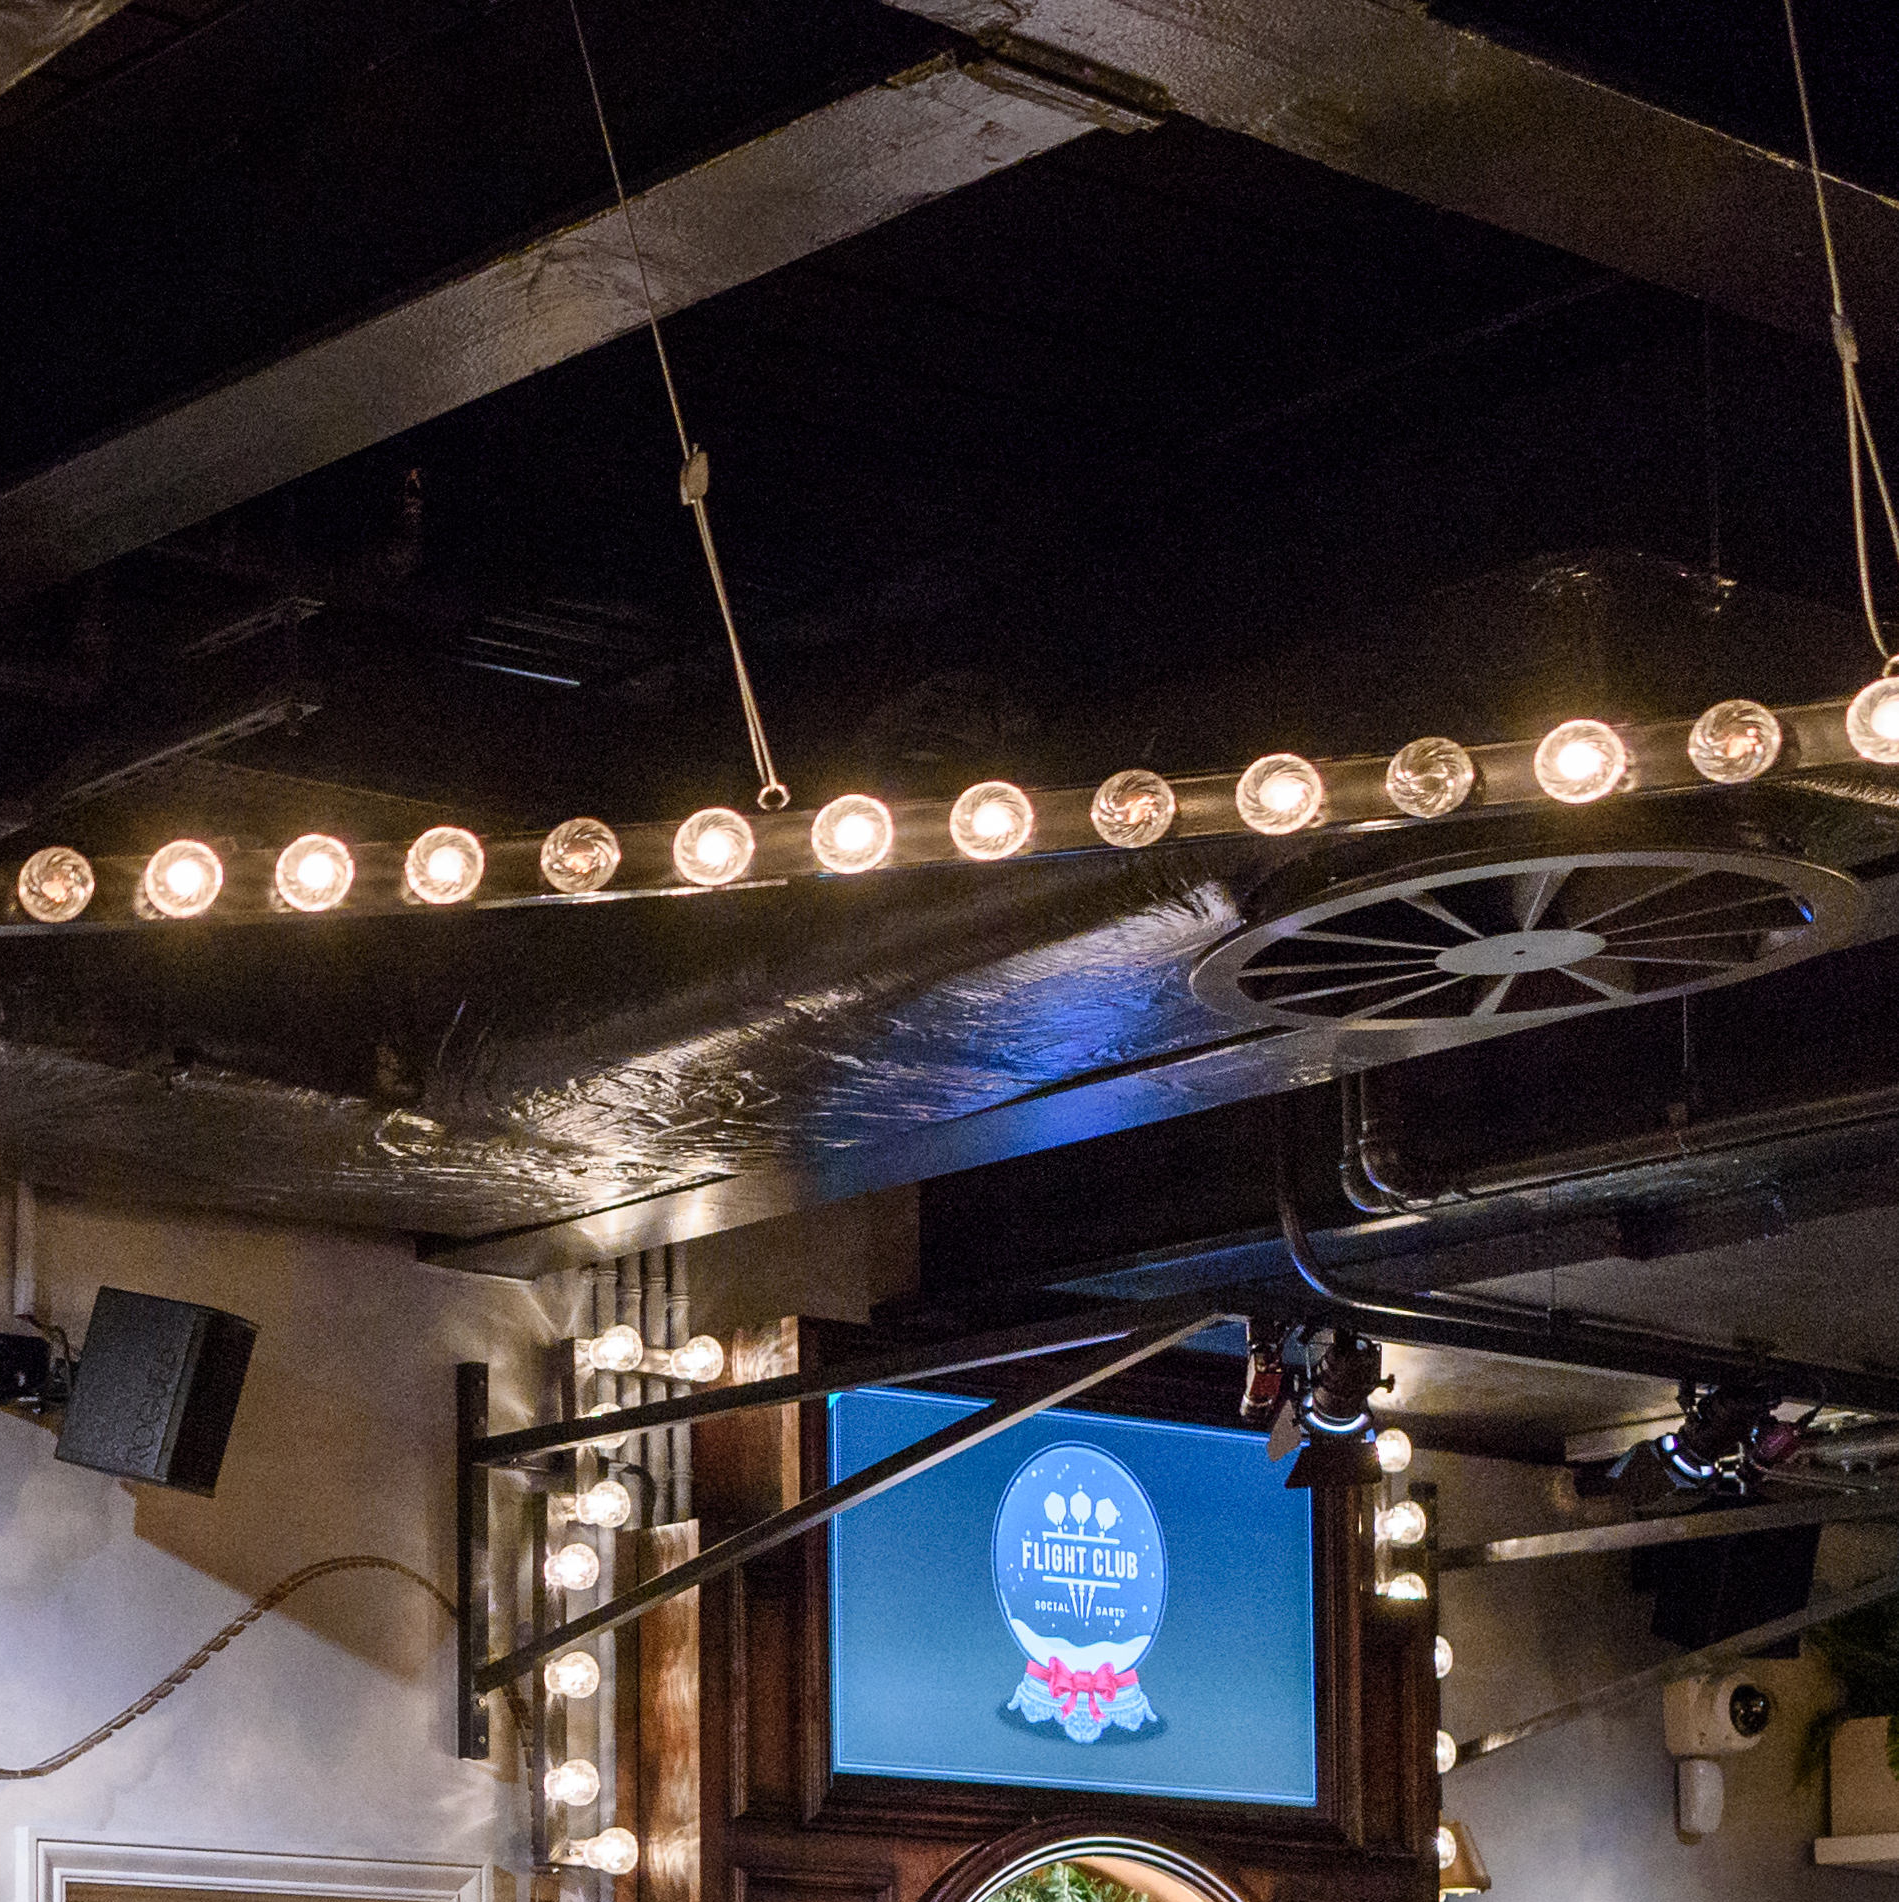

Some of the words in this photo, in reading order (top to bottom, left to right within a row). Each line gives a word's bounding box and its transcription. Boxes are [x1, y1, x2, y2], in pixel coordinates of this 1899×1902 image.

[1022, 1540, 1087, 1574] FLIGHT
[1092, 1548, 1139, 1580] CLUB
[1035, 1600, 1070, 1613] SOCIAL
[1095, 1606, 1126, 1618] DARTS
